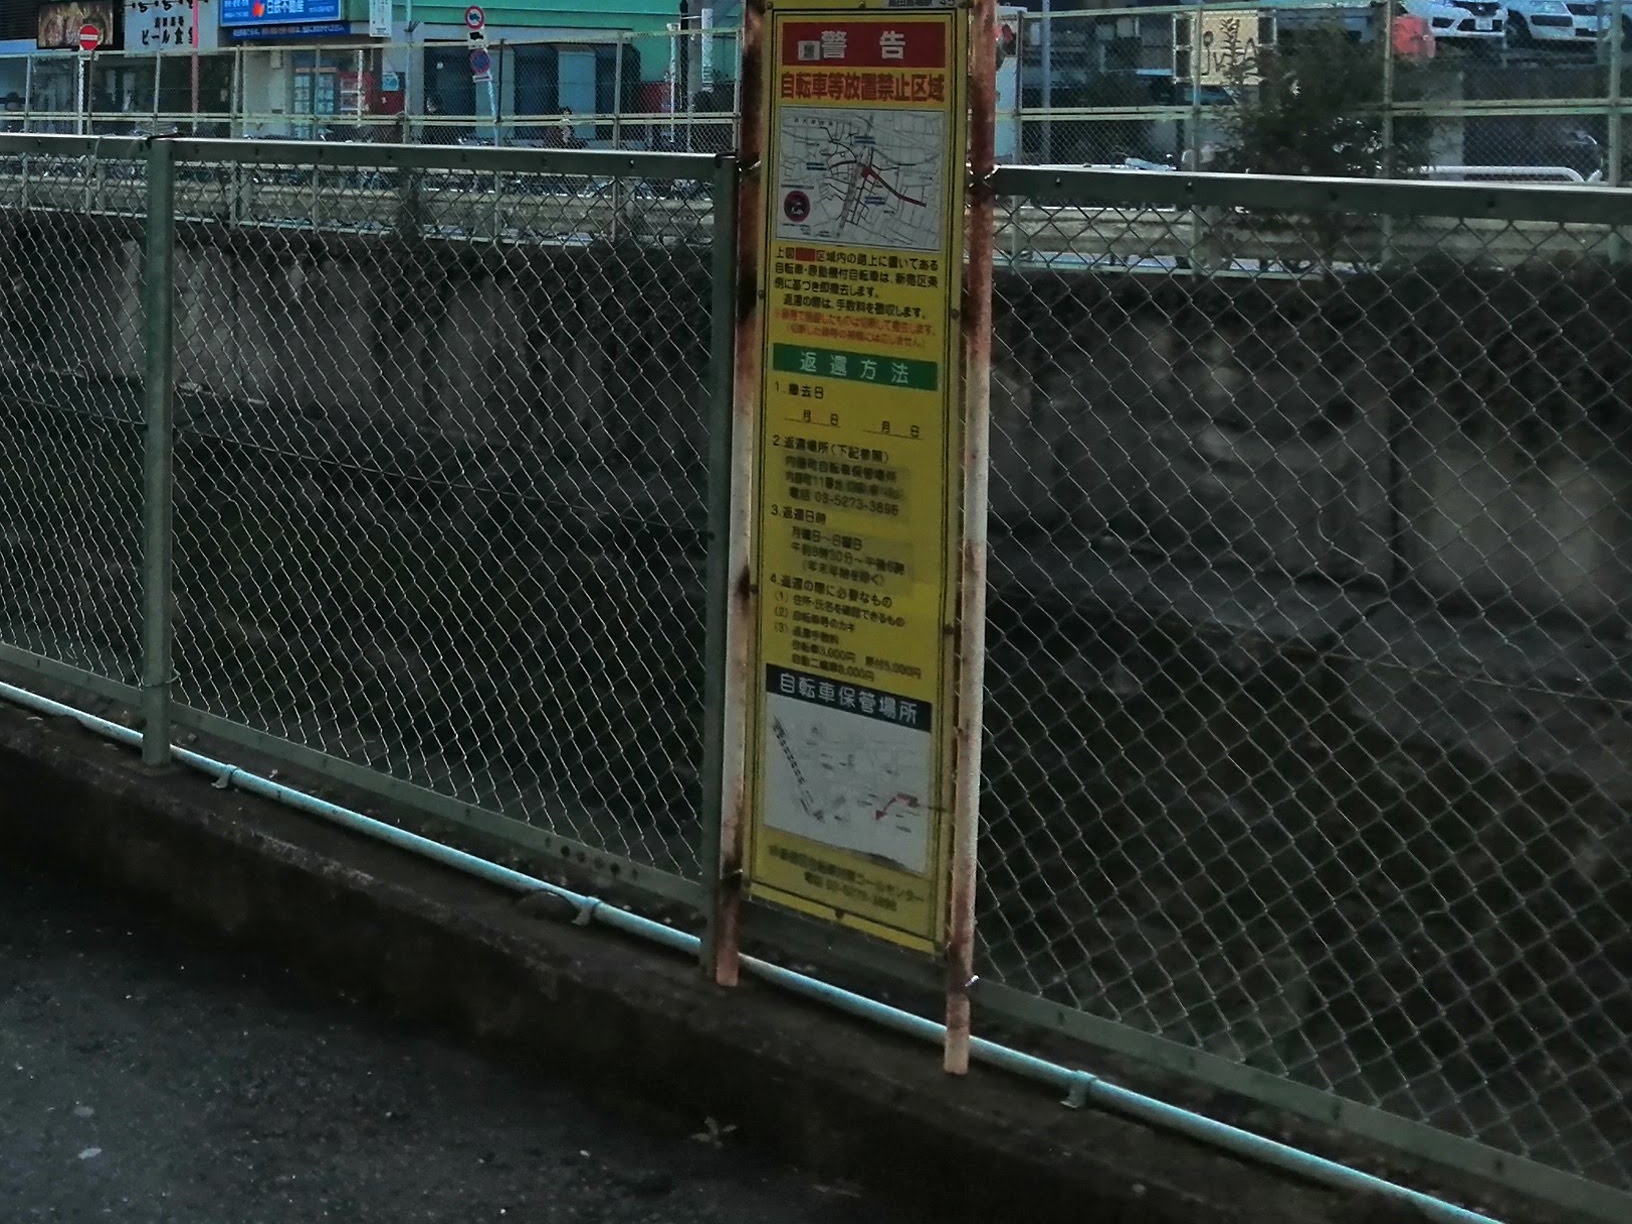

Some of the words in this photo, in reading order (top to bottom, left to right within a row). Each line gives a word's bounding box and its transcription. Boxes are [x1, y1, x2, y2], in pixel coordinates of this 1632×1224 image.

[780, 71, 946, 103] 自転車等放置禁止区域
[800, 351, 909, 385] 返還方法
[780, 673, 917, 724] 自転車保管場所
